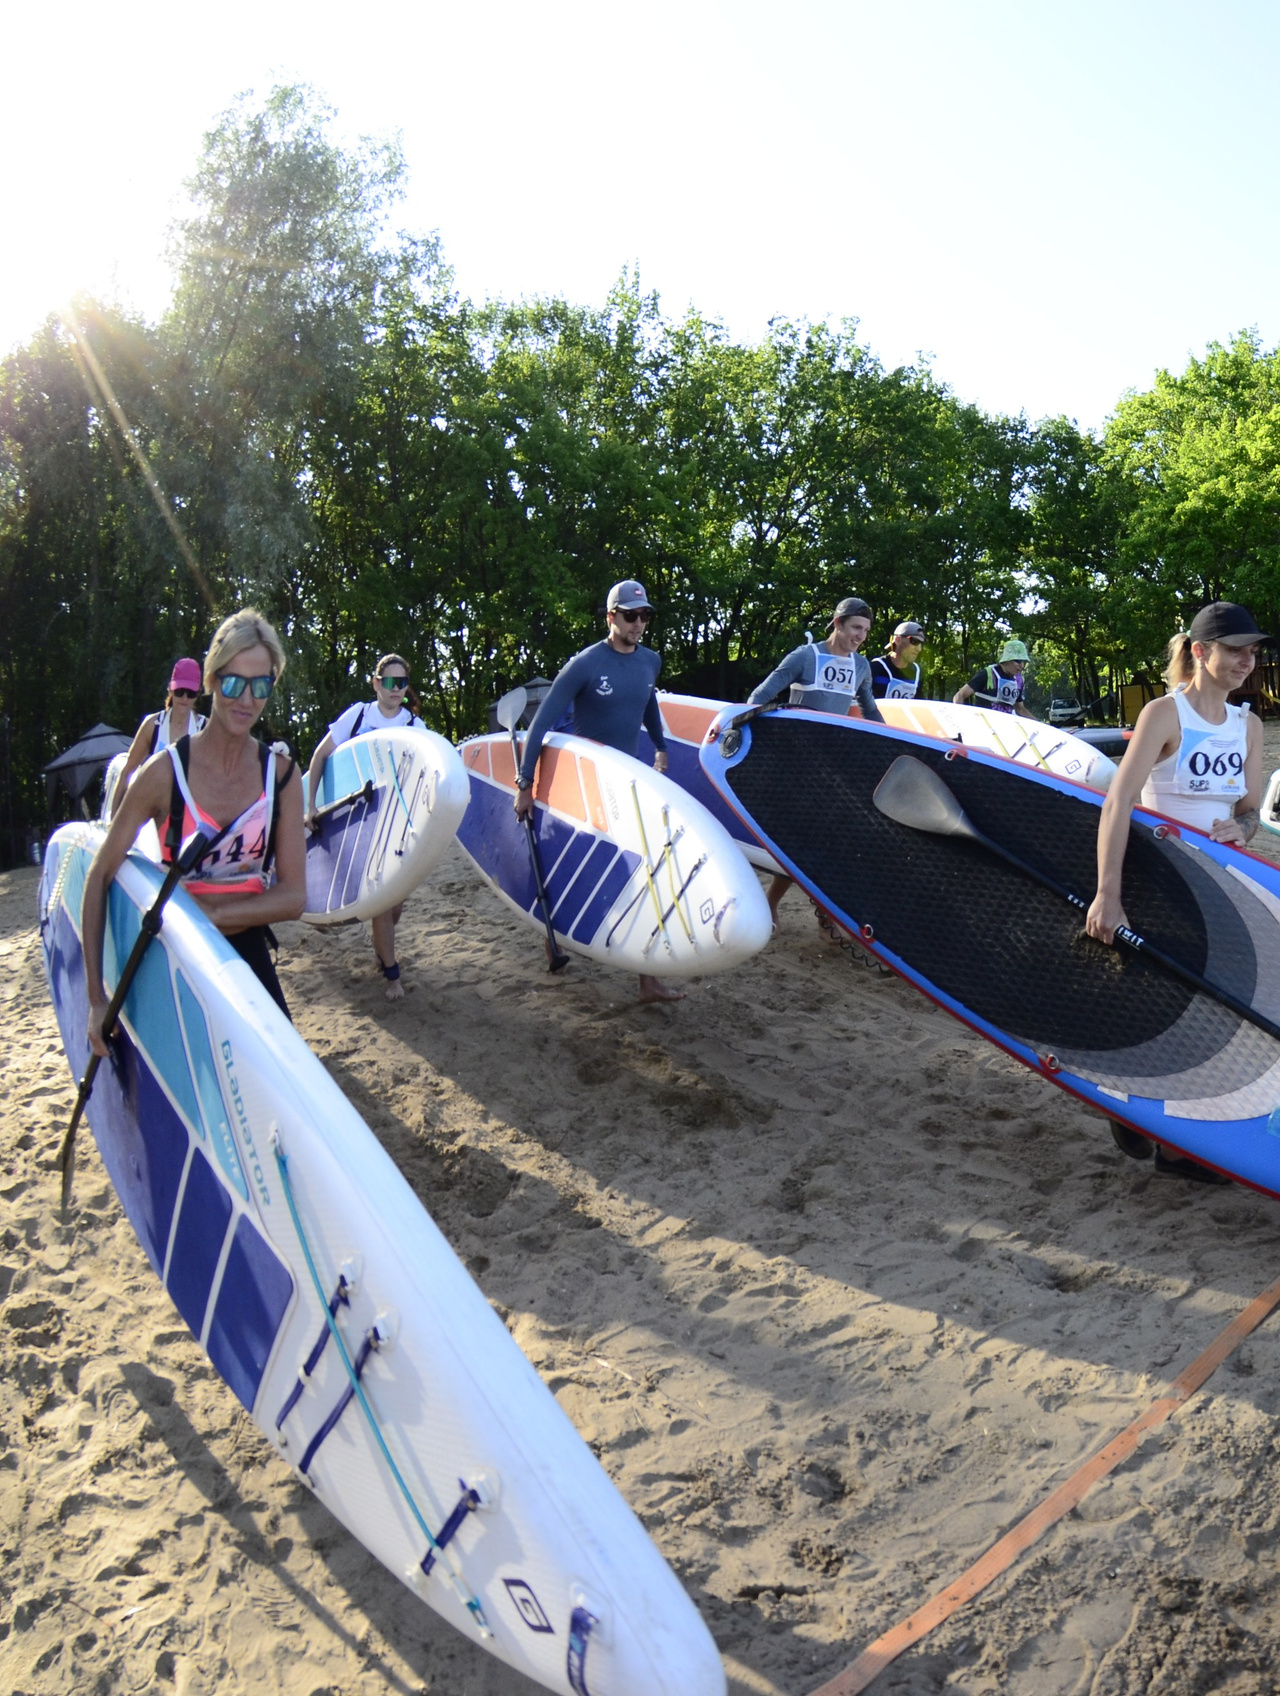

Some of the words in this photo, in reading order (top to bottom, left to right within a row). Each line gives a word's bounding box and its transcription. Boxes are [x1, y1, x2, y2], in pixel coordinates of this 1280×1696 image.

[825, 666, 854, 684] 057
[1189, 751, 1243, 777] 069
[219, 1121, 241, 1180] ELITE
